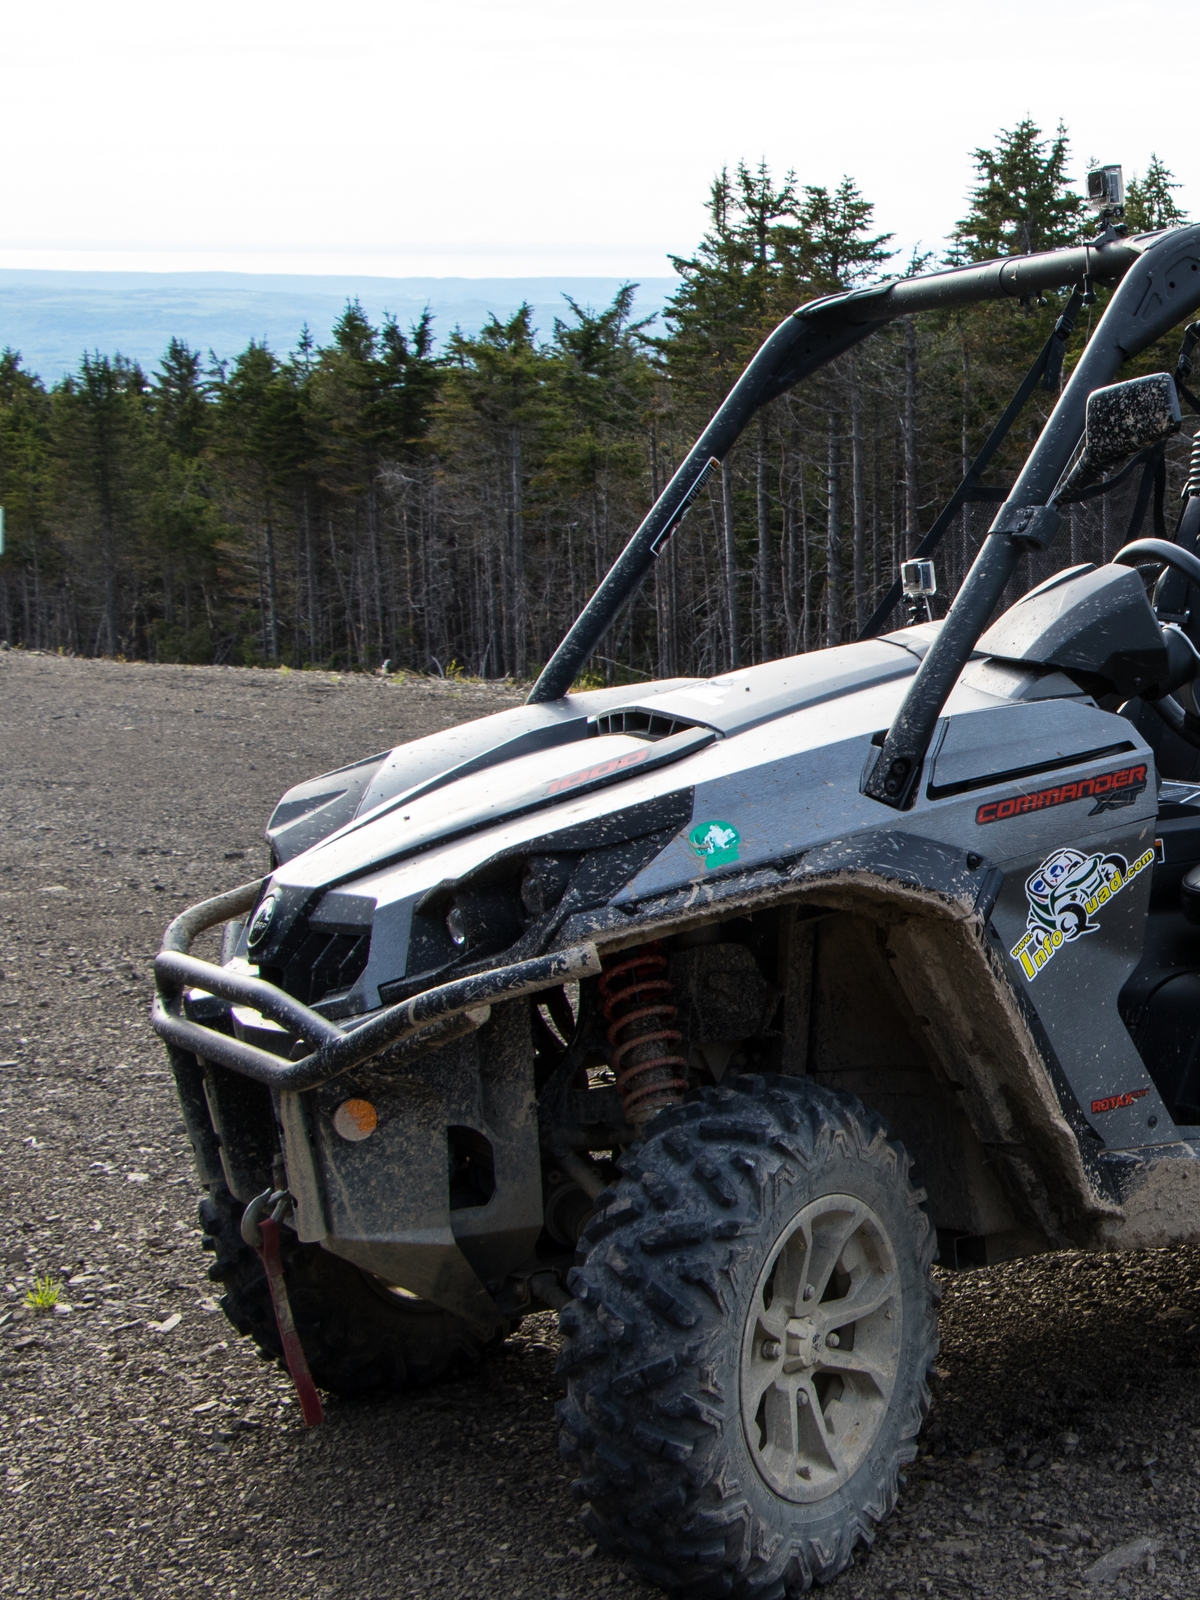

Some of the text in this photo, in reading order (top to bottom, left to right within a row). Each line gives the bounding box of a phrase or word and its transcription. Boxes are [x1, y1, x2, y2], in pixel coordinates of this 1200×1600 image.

[547, 749, 650, 795] 1000
[976, 765, 1147, 824] COMMANDER
[1088, 786, 1147, 816] XT
[1091, 1093, 1135, 1114] ROTAX
